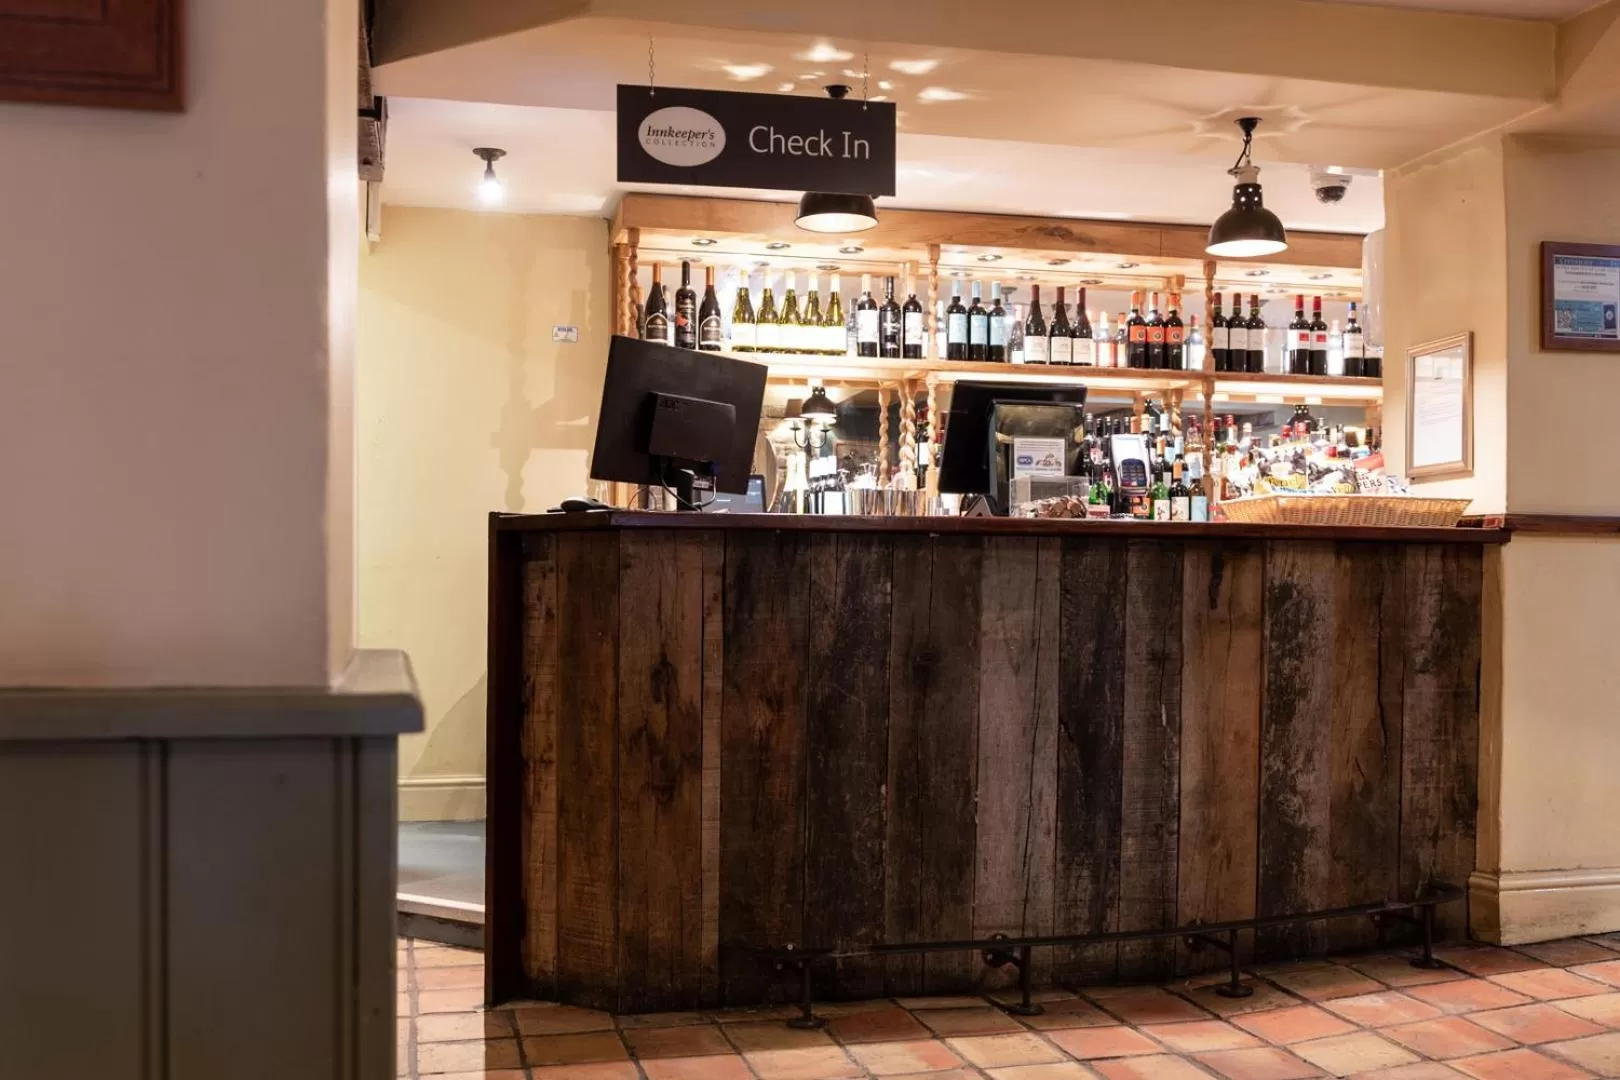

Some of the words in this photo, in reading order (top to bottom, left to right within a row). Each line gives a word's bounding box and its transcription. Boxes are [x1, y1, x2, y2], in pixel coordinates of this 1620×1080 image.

[646, 125, 715, 142] Innkeeper's
[749, 125, 833, 157] Check
[842, 131, 870, 159] In
[645, 138, 716, 148] COLLECTION
